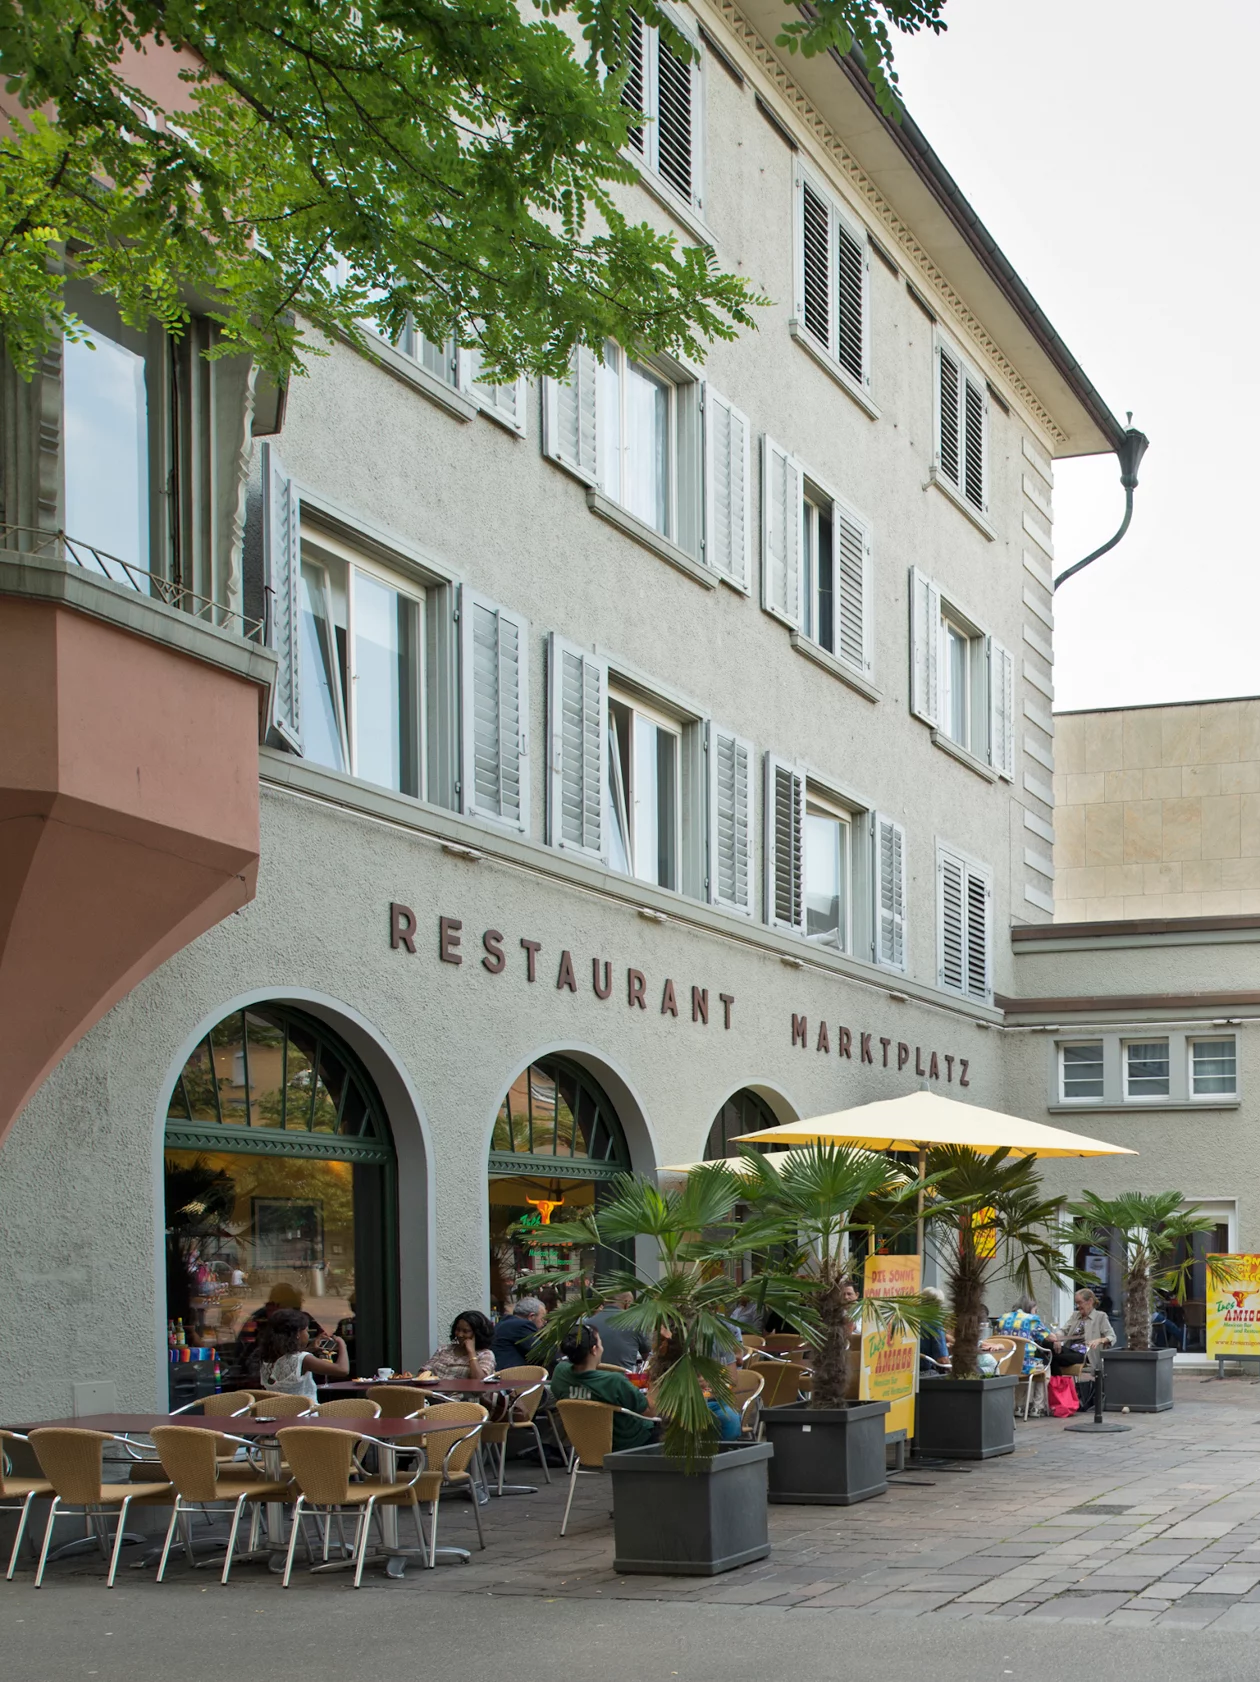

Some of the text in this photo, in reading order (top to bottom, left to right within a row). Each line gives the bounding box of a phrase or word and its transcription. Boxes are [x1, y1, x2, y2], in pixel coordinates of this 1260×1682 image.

[389, 901, 972, 1087] RESTAURANT MARKTPLATZ
[871, 1268, 915, 1284] DIE SONNE
[875, 1347, 912, 1374] AMIGOS
